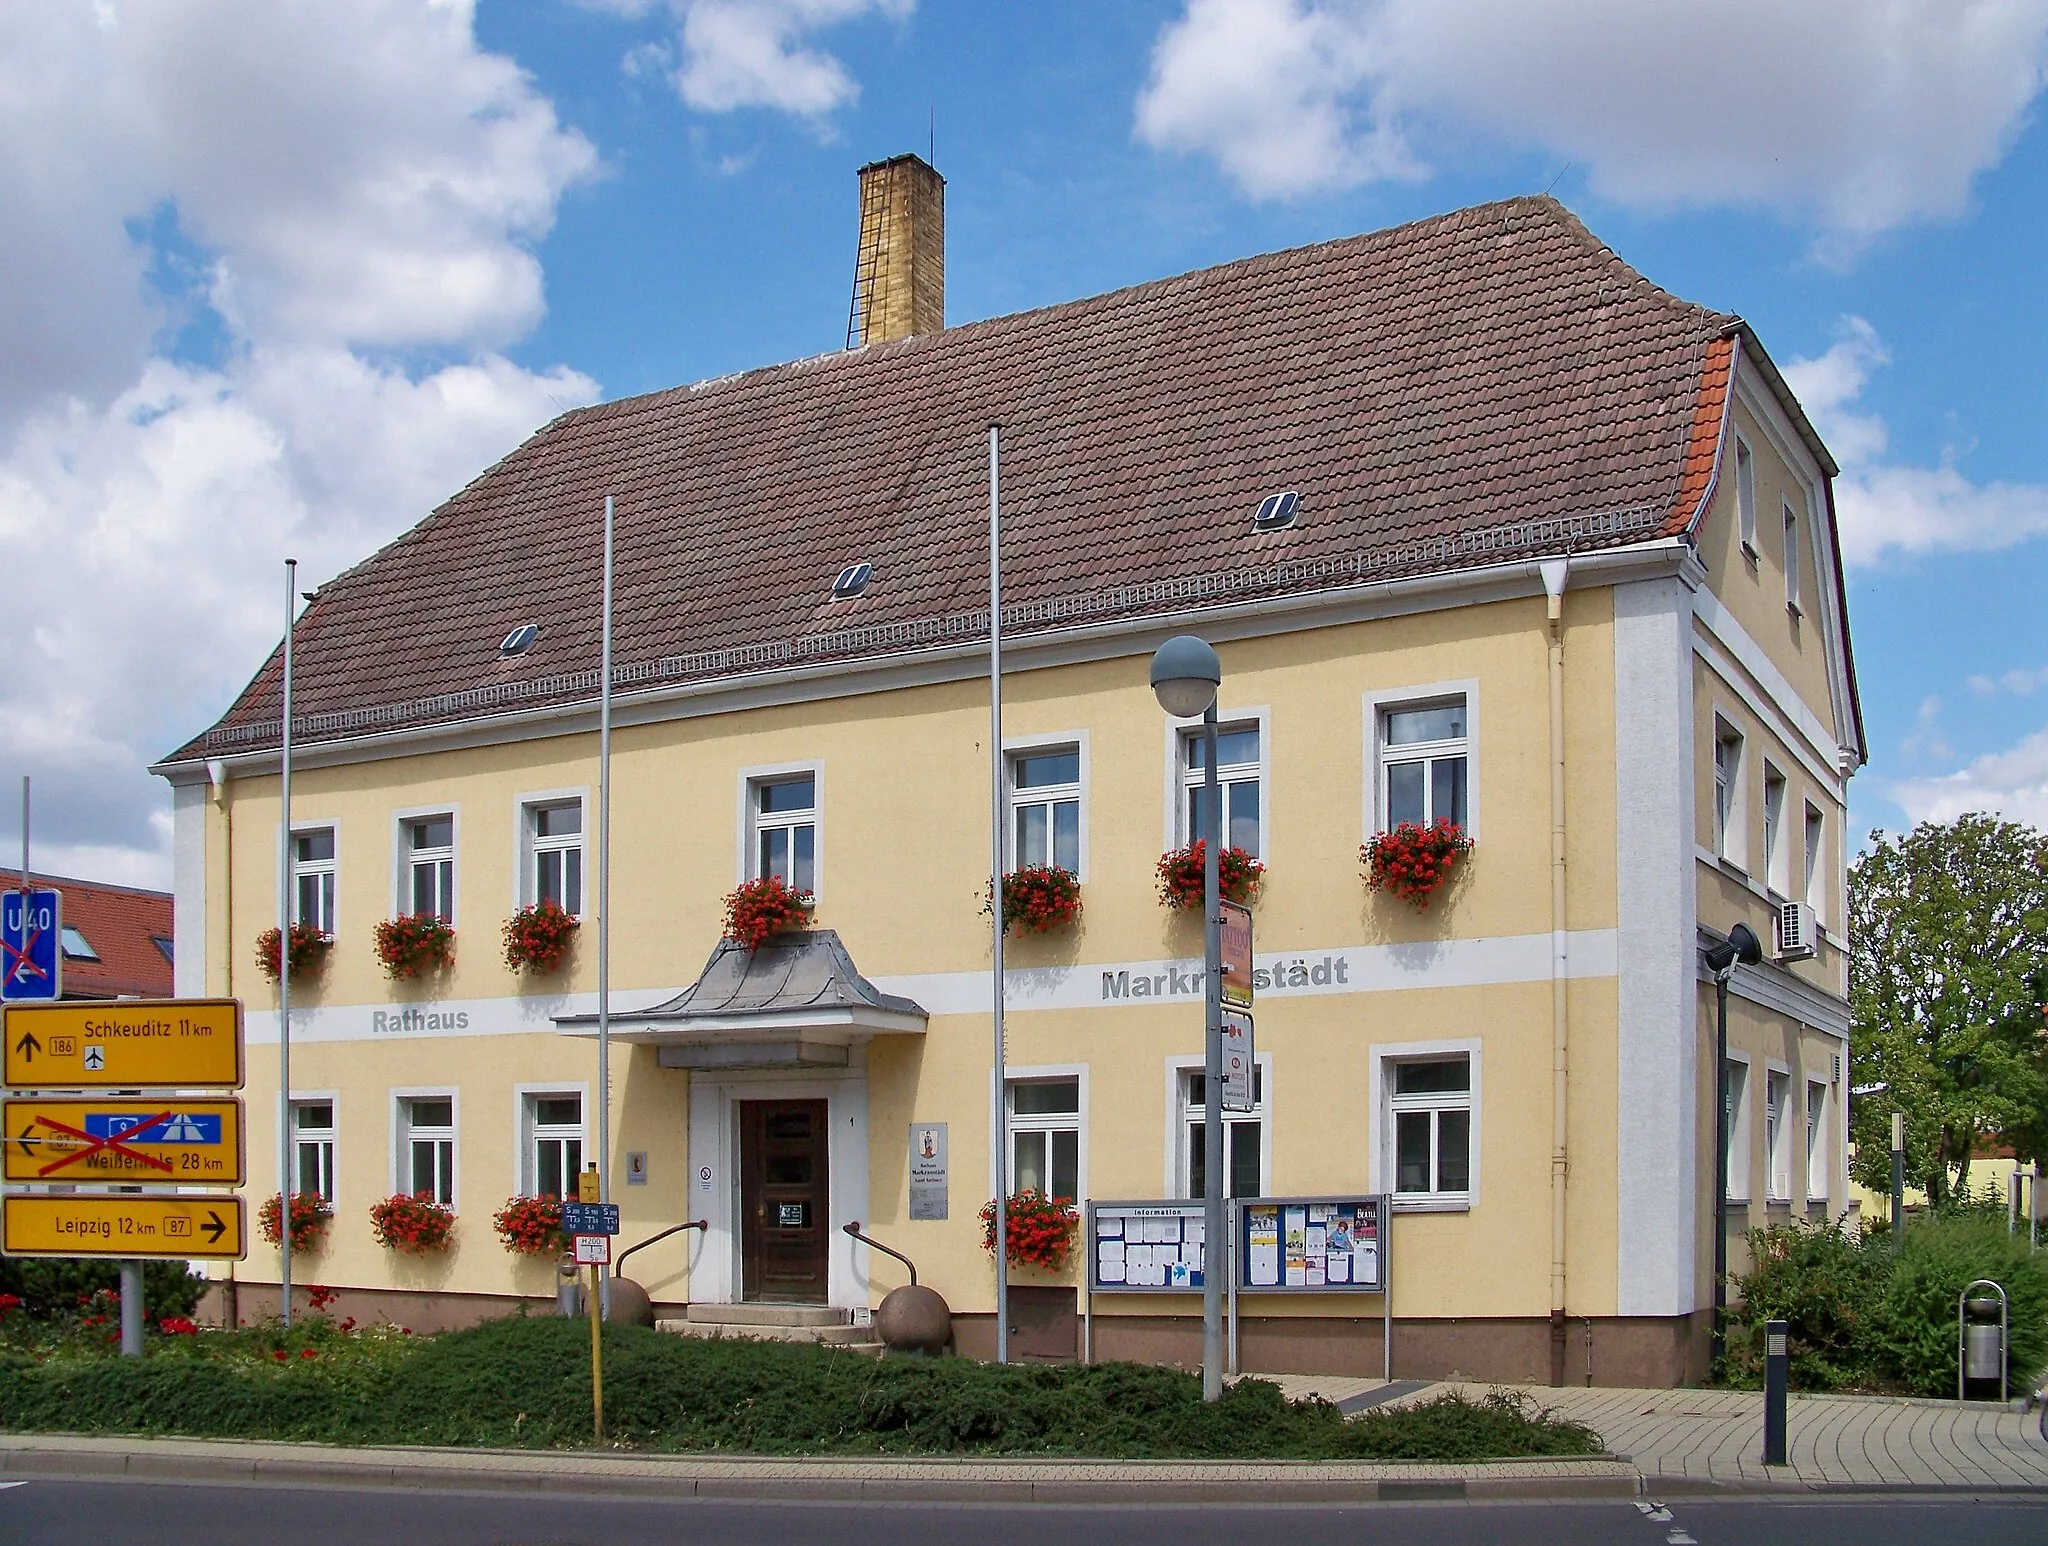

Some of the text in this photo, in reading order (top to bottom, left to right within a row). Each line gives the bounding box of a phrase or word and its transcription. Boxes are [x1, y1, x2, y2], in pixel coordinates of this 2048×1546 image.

[1102, 956, 1349, 1000] Markrstädt
[84, 1019, 212, 1038] Schkeuditz 11 km
[373, 1009, 469, 1033] Rathaus
[53, 1040, 72, 1053] 186
[850, 1116, 854, 1127] 1
[181, 1153, 200, 1170] 28
[204, 1157, 223, 1170] km
[56, 1217, 155, 1238] Leipzig 12 km
[170, 1220, 185, 1233] 87
